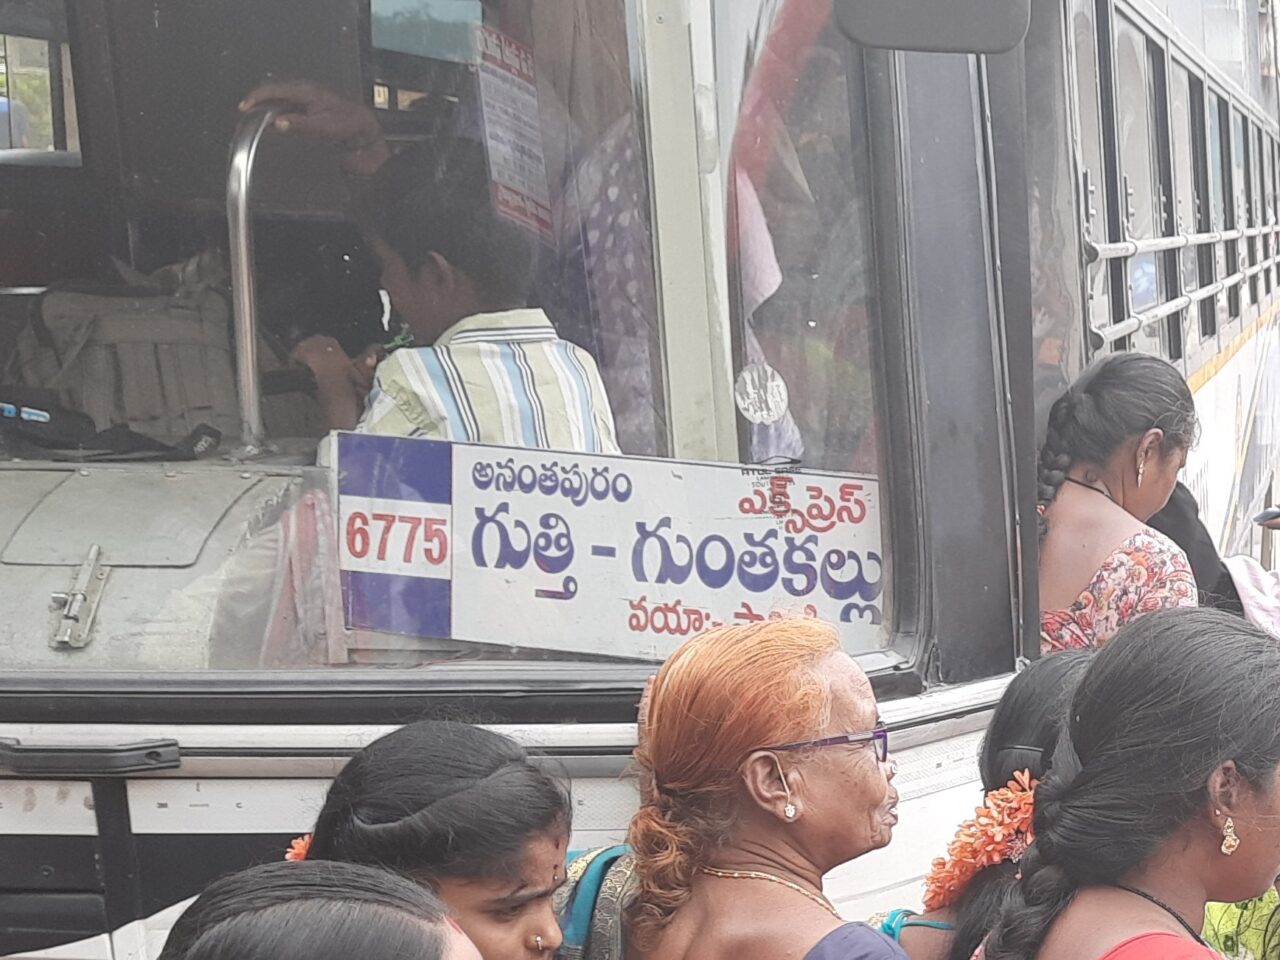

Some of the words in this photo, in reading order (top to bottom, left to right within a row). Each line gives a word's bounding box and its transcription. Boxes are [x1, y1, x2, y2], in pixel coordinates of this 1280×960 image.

[472, 457, 633, 507] అనంతపురం
[346, 511, 449, 566] 6775
[471, 501, 579, 601] గుత్తి
[631, 516, 882, 626] గుంతకల్లు
